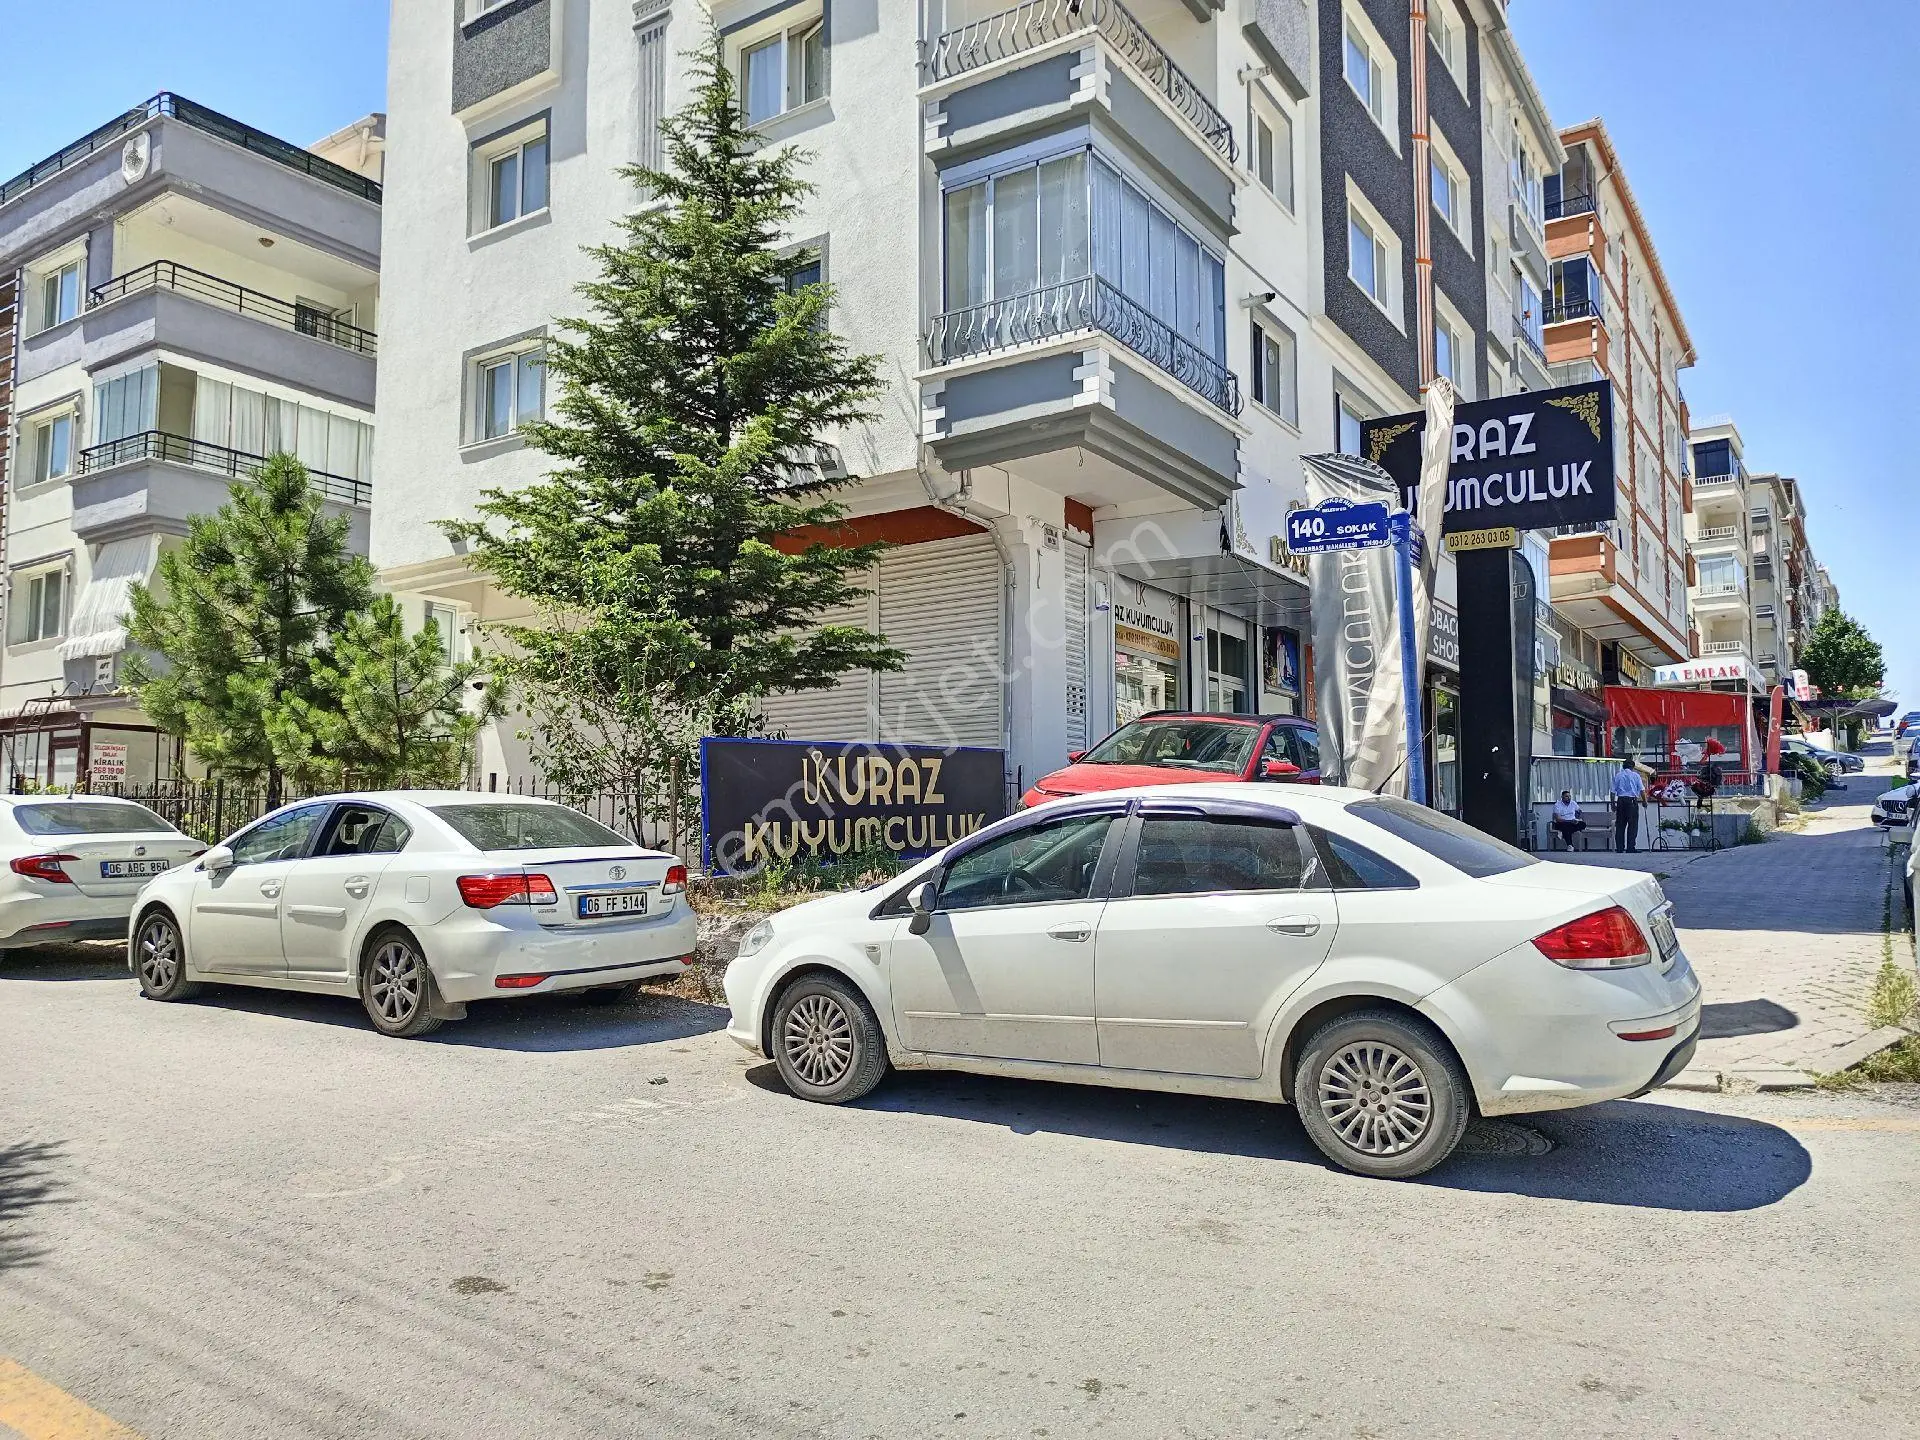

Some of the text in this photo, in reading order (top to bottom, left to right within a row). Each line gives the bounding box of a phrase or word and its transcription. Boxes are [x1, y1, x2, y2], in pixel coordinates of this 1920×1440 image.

[1421, 412, 1537, 464] RAZ
[1336, 522, 1378, 535] SOKAK
[1449, 530, 1510, 547] 0312 263 03 05
[1125, 608, 1174, 637] KUYUMCULUK
[1433, 634, 1459, 661] SHOP
[1682, 665, 1741, 680] EMLAK
[93, 758, 125, 766] KİRALIK
[109, 861, 167, 874] 06 ABG 864
[587, 894, 645, 912] 06 FF 5144
